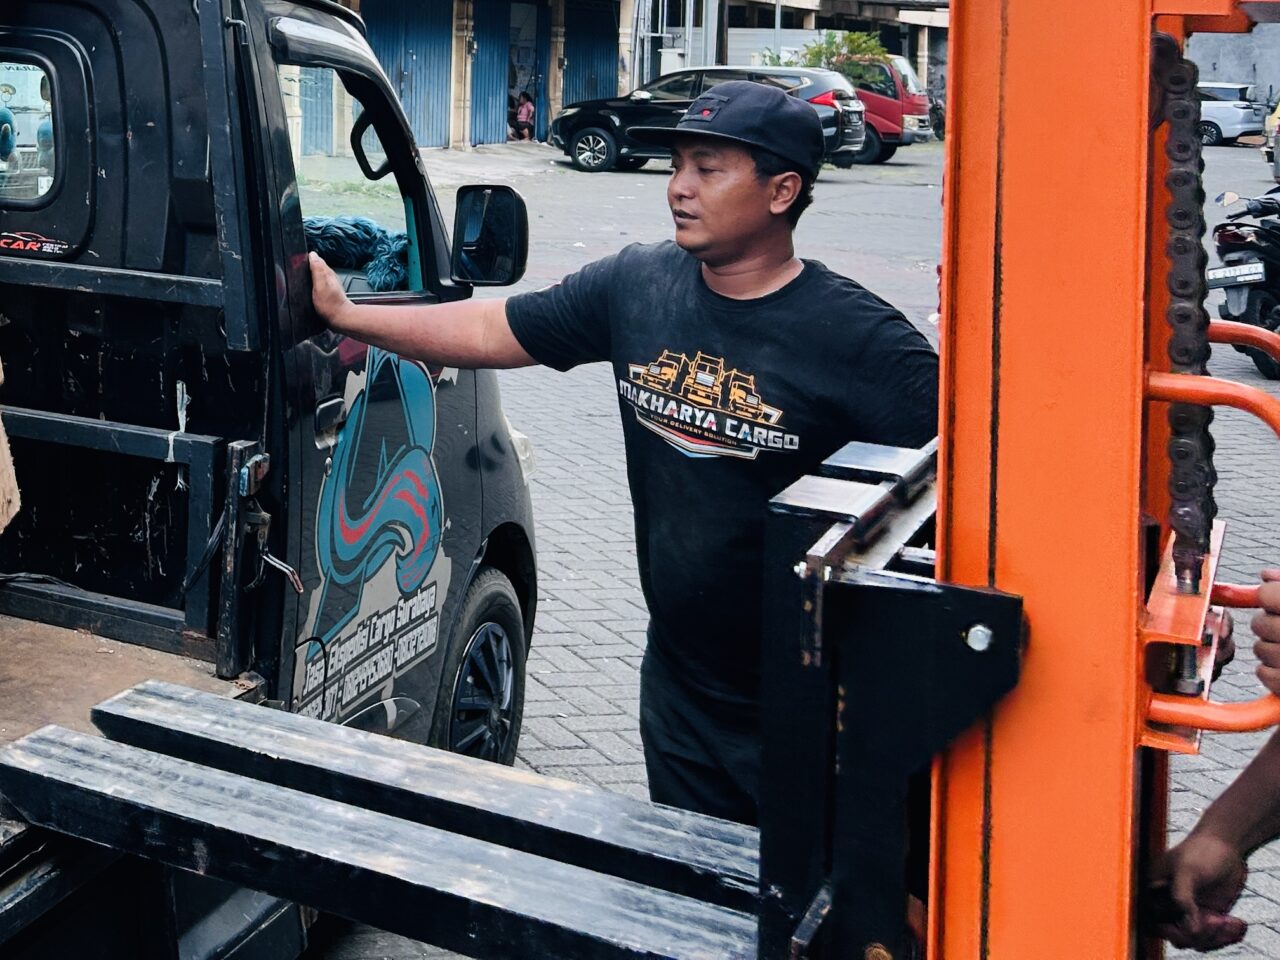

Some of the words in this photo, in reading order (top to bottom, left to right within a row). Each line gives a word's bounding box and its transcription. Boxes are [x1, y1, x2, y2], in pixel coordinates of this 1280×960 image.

[0, 239, 42, 251] CAR
[619, 380, 717, 431] MAKHARYA
[725, 418, 800, 450] CARGO
[650, 414, 668, 424] YOUR
[670, 420, 703, 435] DELIVERY
[704, 431, 737, 446] SOLUTION
